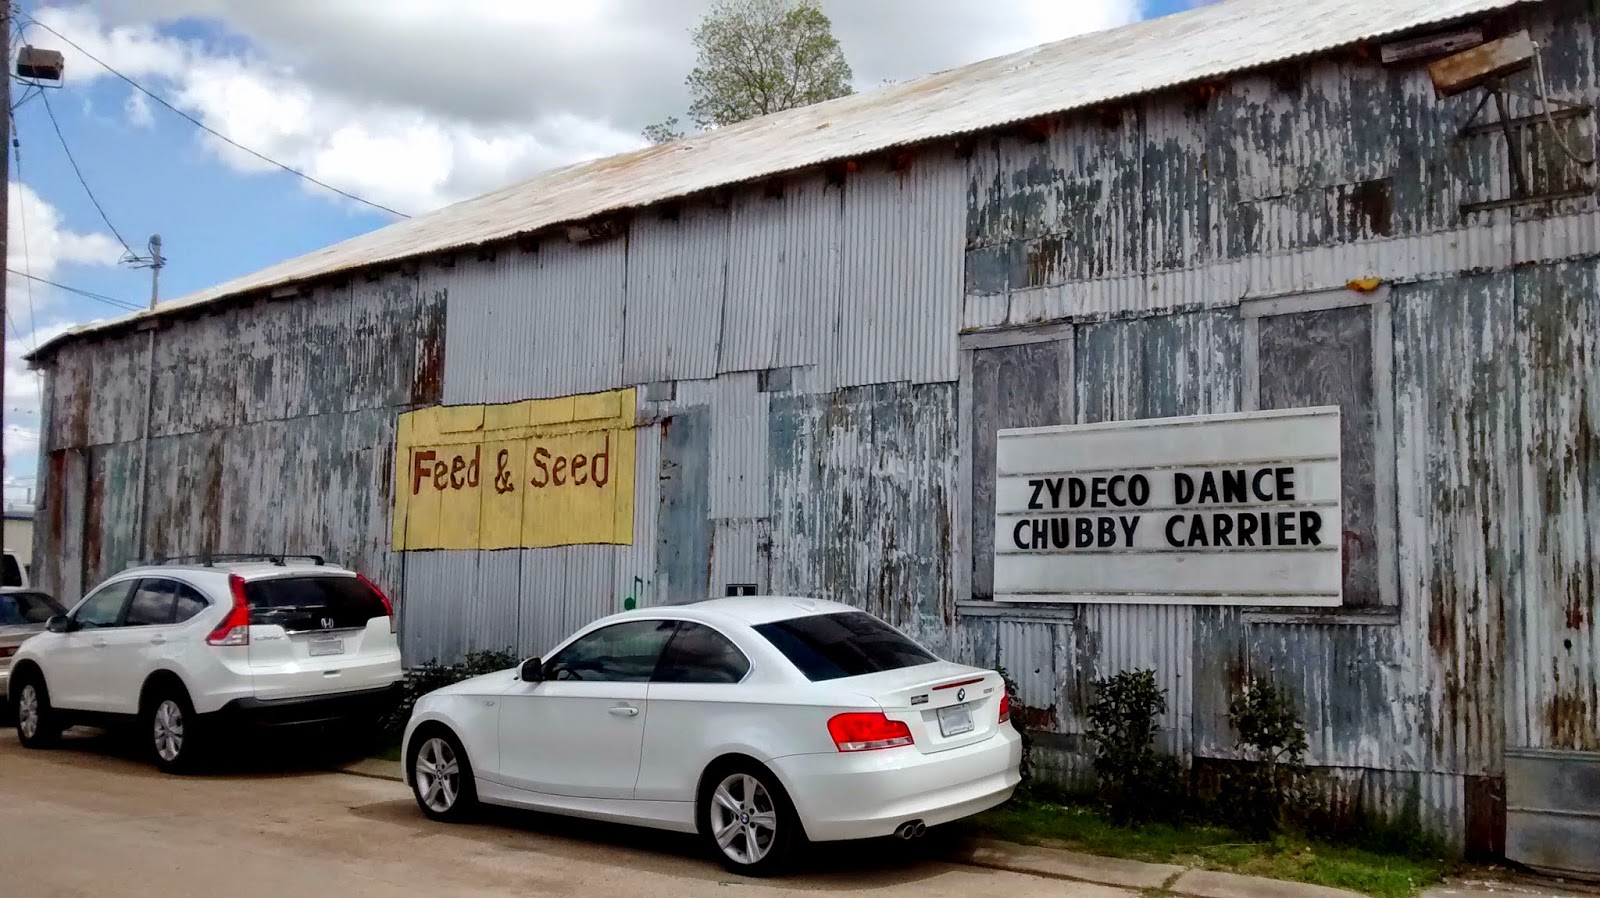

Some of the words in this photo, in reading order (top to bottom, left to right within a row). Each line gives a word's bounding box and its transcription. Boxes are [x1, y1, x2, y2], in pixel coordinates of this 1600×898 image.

[413, 444, 481, 495] Feed
[494, 448, 515, 495] &
[530, 428, 610, 489] Seed
[1027, 473, 1151, 510] ZYDECO
[1173, 466, 1296, 506] DANCE
[1013, 515, 1141, 550] CHUBBY
[1164, 510, 1323, 549] CARRIER
